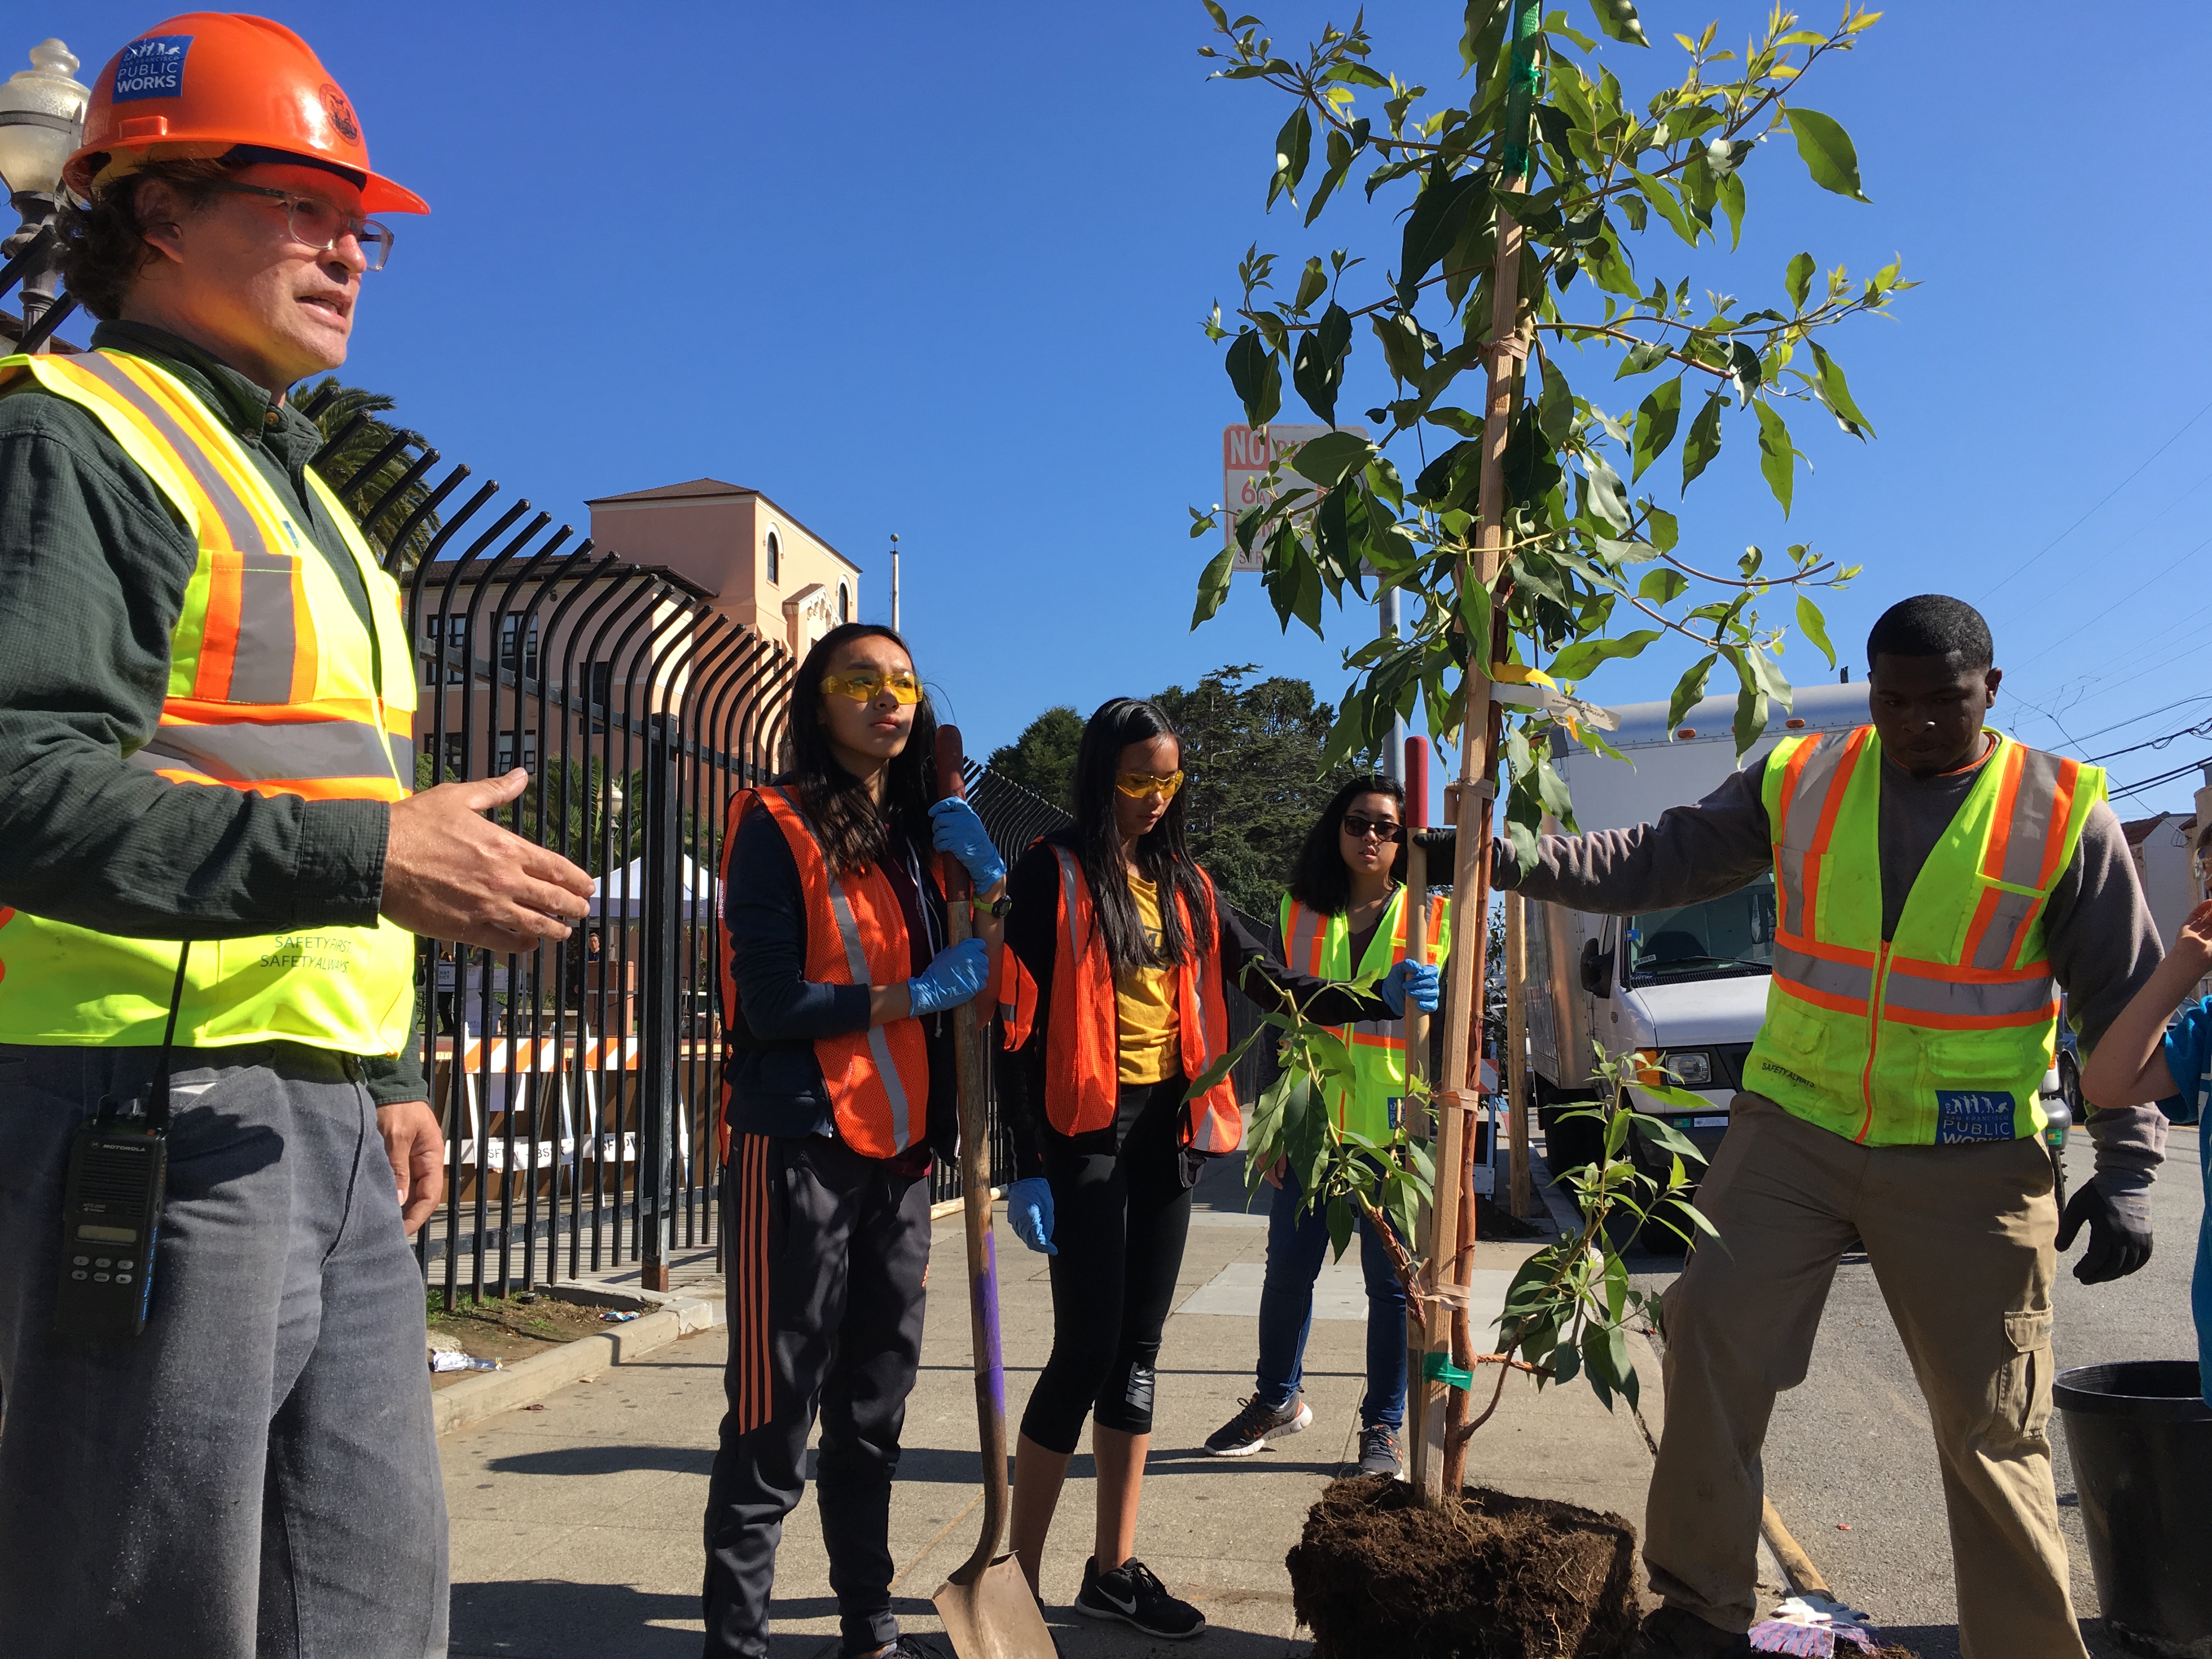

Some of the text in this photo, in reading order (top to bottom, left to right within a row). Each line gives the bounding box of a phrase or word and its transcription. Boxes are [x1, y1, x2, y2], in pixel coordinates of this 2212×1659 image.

[118, 62, 178, 80] PUBLIC
[117, 75, 176, 93] WORKS
[1231, 430, 1265, 465] NO
[1241, 476, 1256, 504] 6
[275, 936, 352, 954] SAFETY FIRST.
[260, 955, 349, 973] SAFETY ALWAYS.
[1762, 1062, 1788, 1075] SAFETY
[1943, 1119, 2010, 1136] PUBLIC
[103, 1143, 145, 1152] MOTOROLA
